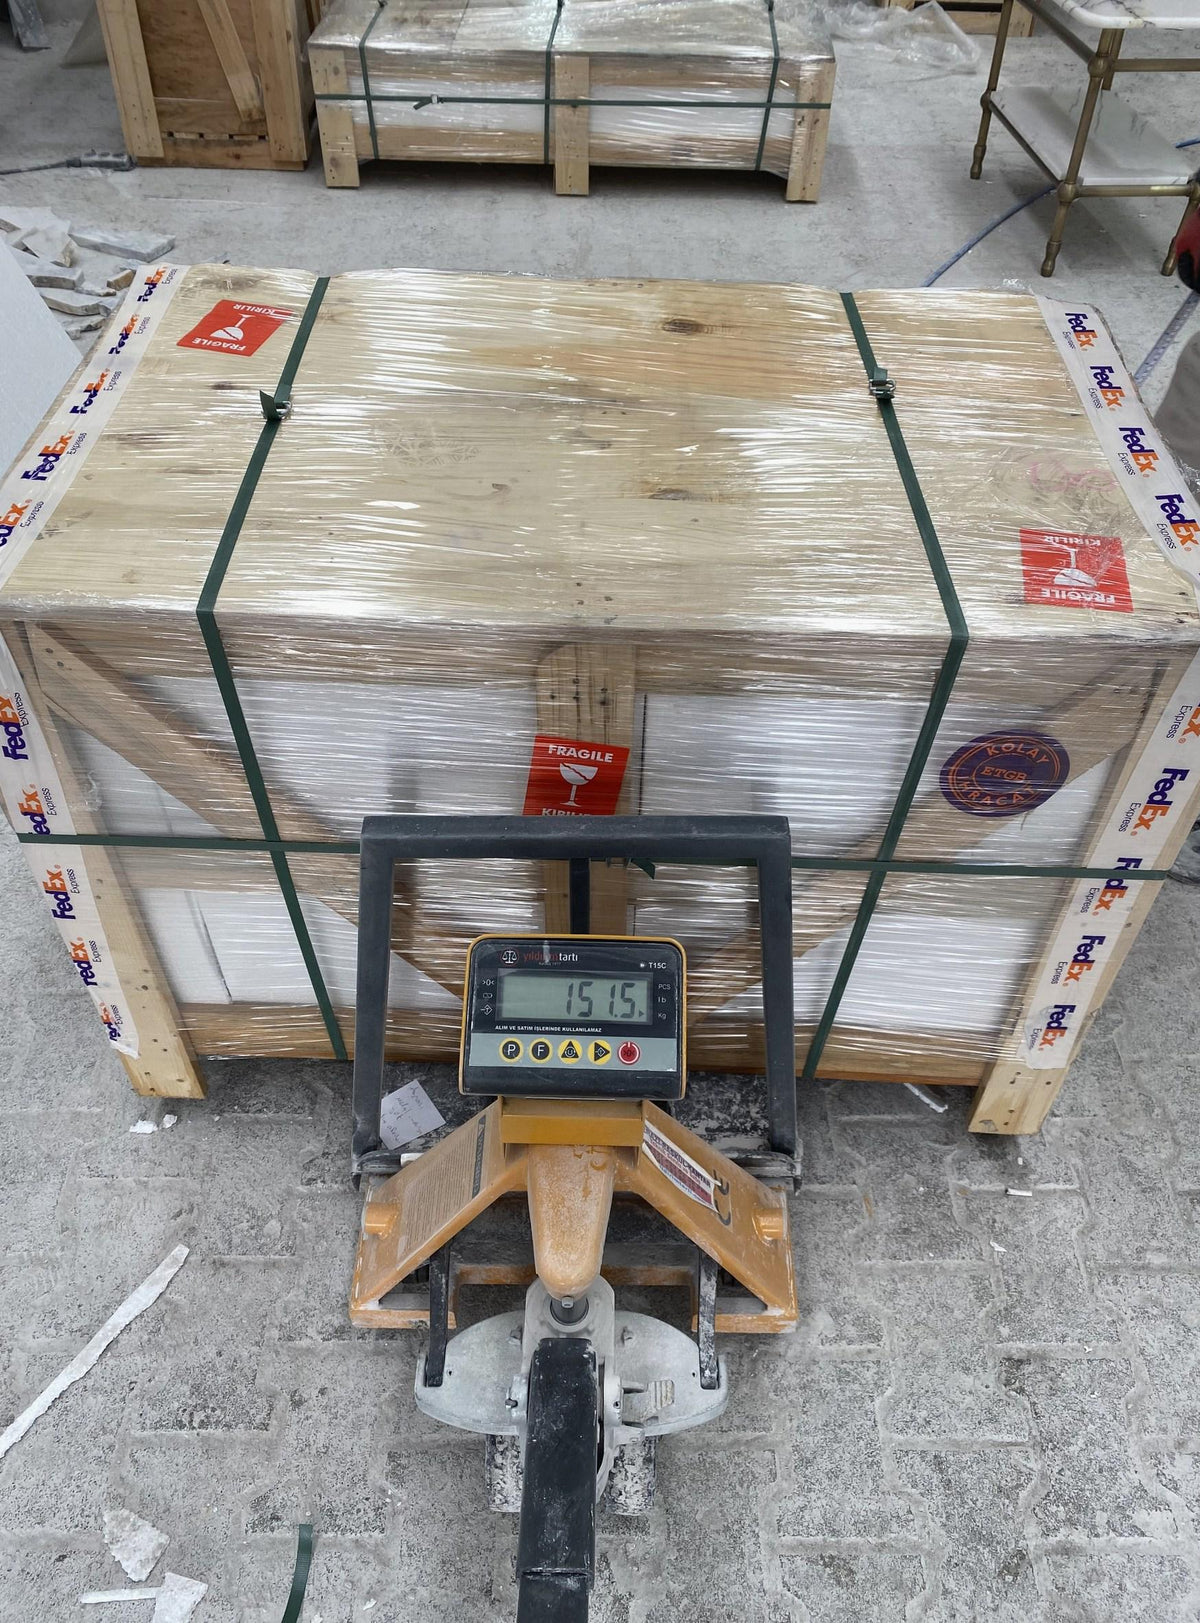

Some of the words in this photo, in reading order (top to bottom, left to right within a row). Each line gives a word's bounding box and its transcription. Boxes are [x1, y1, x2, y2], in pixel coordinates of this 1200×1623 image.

[137, 269, 167, 302] FedEx
[233, 303, 276, 316] KIRILIR
[192, 337, 246, 351] FRAGILE
[1065, 313, 1098, 347] FedEx
[69, 372, 109, 414] FedEx
[1088, 388, 1104, 409] Express
[1090, 366, 1126, 408] FedEx
[20, 434, 73, 481] FedEx
[66, 432, 87, 455] Express
[1118, 427, 1160, 473] FedEx
[1118, 452, 1136, 477] Express
[1154, 494, 1200, 546] FedEx
[1156, 523, 1177, 550] Express
[1041, 587, 1116, 605] FRAGILE
[14, 692, 30, 727] Express
[1166, 705, 1193, 739] Express
[0, 695, 29, 760] FedEx
[548, 744, 614, 763] FRAGILE
[985, 743, 1050, 763] KOLAY
[18, 788, 51, 835] edEx
[41, 787, 57, 816] Express
[1132, 768, 1190, 830] FedEx
[1118, 802, 1142, 832] Express
[42, 869, 77, 920] FedEx
[66, 868, 80, 894] Express
[1080, 888, 1101, 914] Express
[1050, 961, 1069, 985] Express
[1063, 935, 1106, 983] FedEx
[1040, 1004, 1076, 1047] FedEx
[508, 1045, 516, 1056] P
[537, 1045, 545, 1056] F
